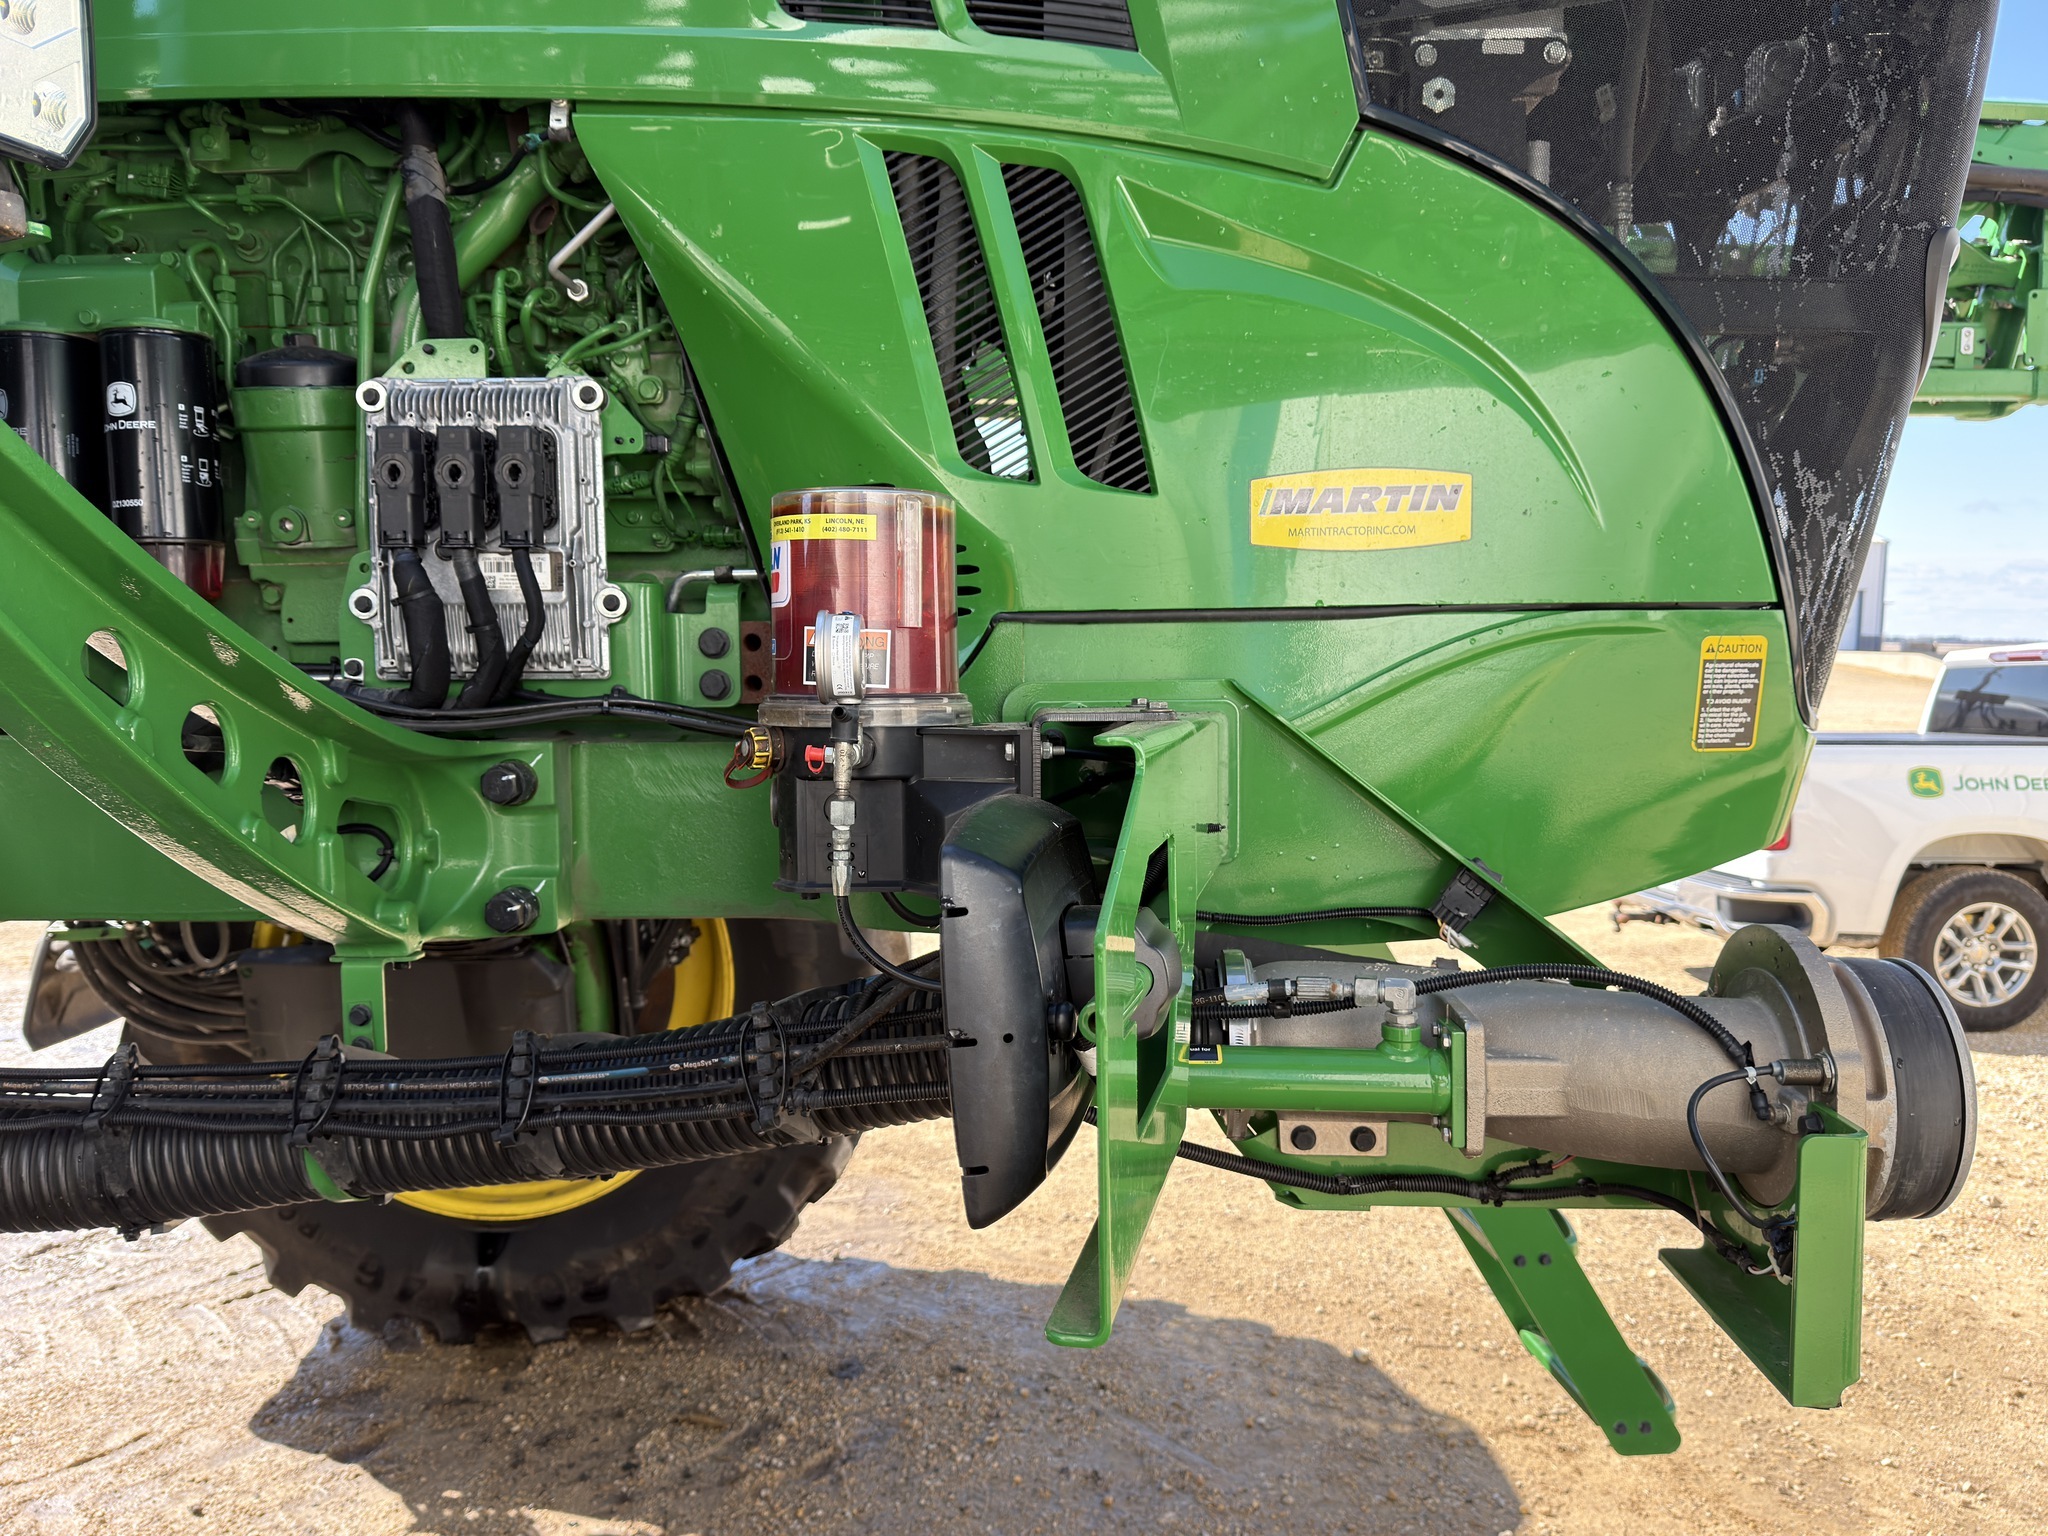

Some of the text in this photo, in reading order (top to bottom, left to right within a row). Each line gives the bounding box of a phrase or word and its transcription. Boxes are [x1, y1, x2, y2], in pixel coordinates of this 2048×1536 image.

[118, 420, 156, 429] DEERE
[1269, 484, 1464, 515] MARTIN
[1288, 525, 1416, 538] MARTINTRACTORINC.COM
[1717, 644, 1762, 654] CAUTION
[1953, 774, 2010, 791] JOHN
[1194, 994, 1224, 1004] 2G-11C
